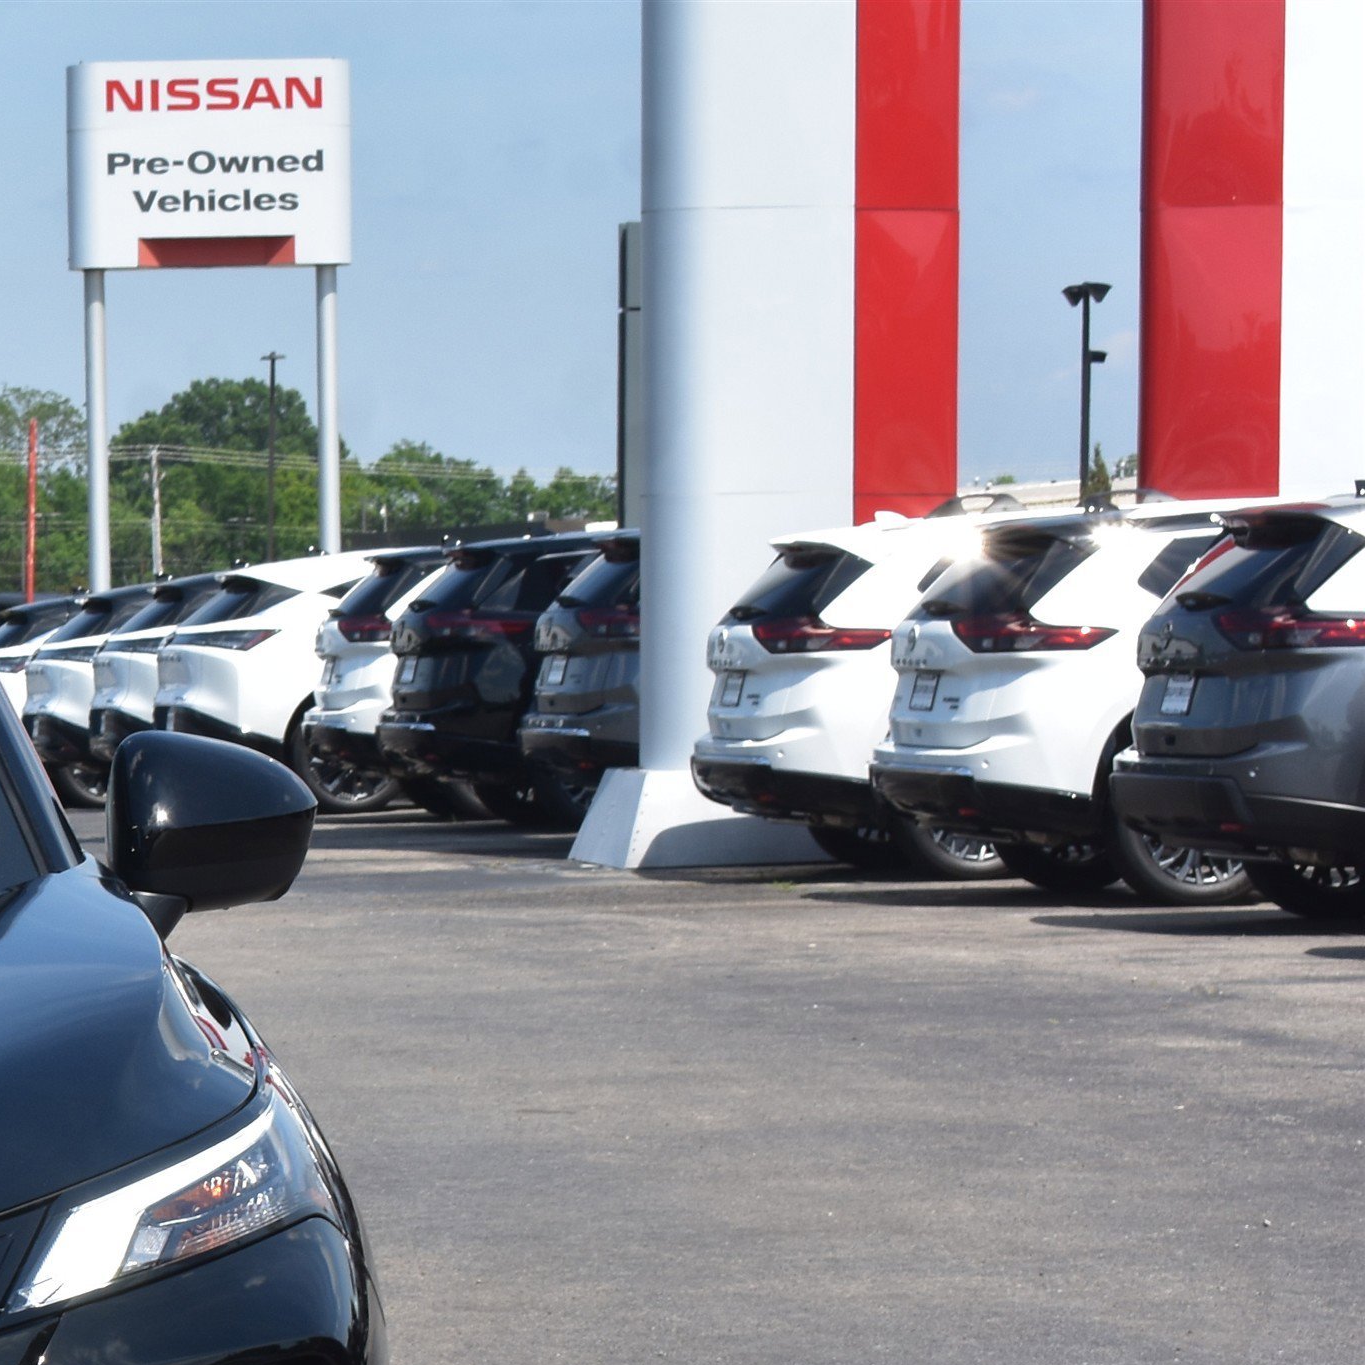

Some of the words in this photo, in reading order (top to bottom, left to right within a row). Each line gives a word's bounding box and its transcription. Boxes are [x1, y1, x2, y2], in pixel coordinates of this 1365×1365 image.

[106, 77, 322, 112] NISSAN
[107, 149, 324, 175] Pre-Owned
[133, 189, 299, 212] Vehicles
